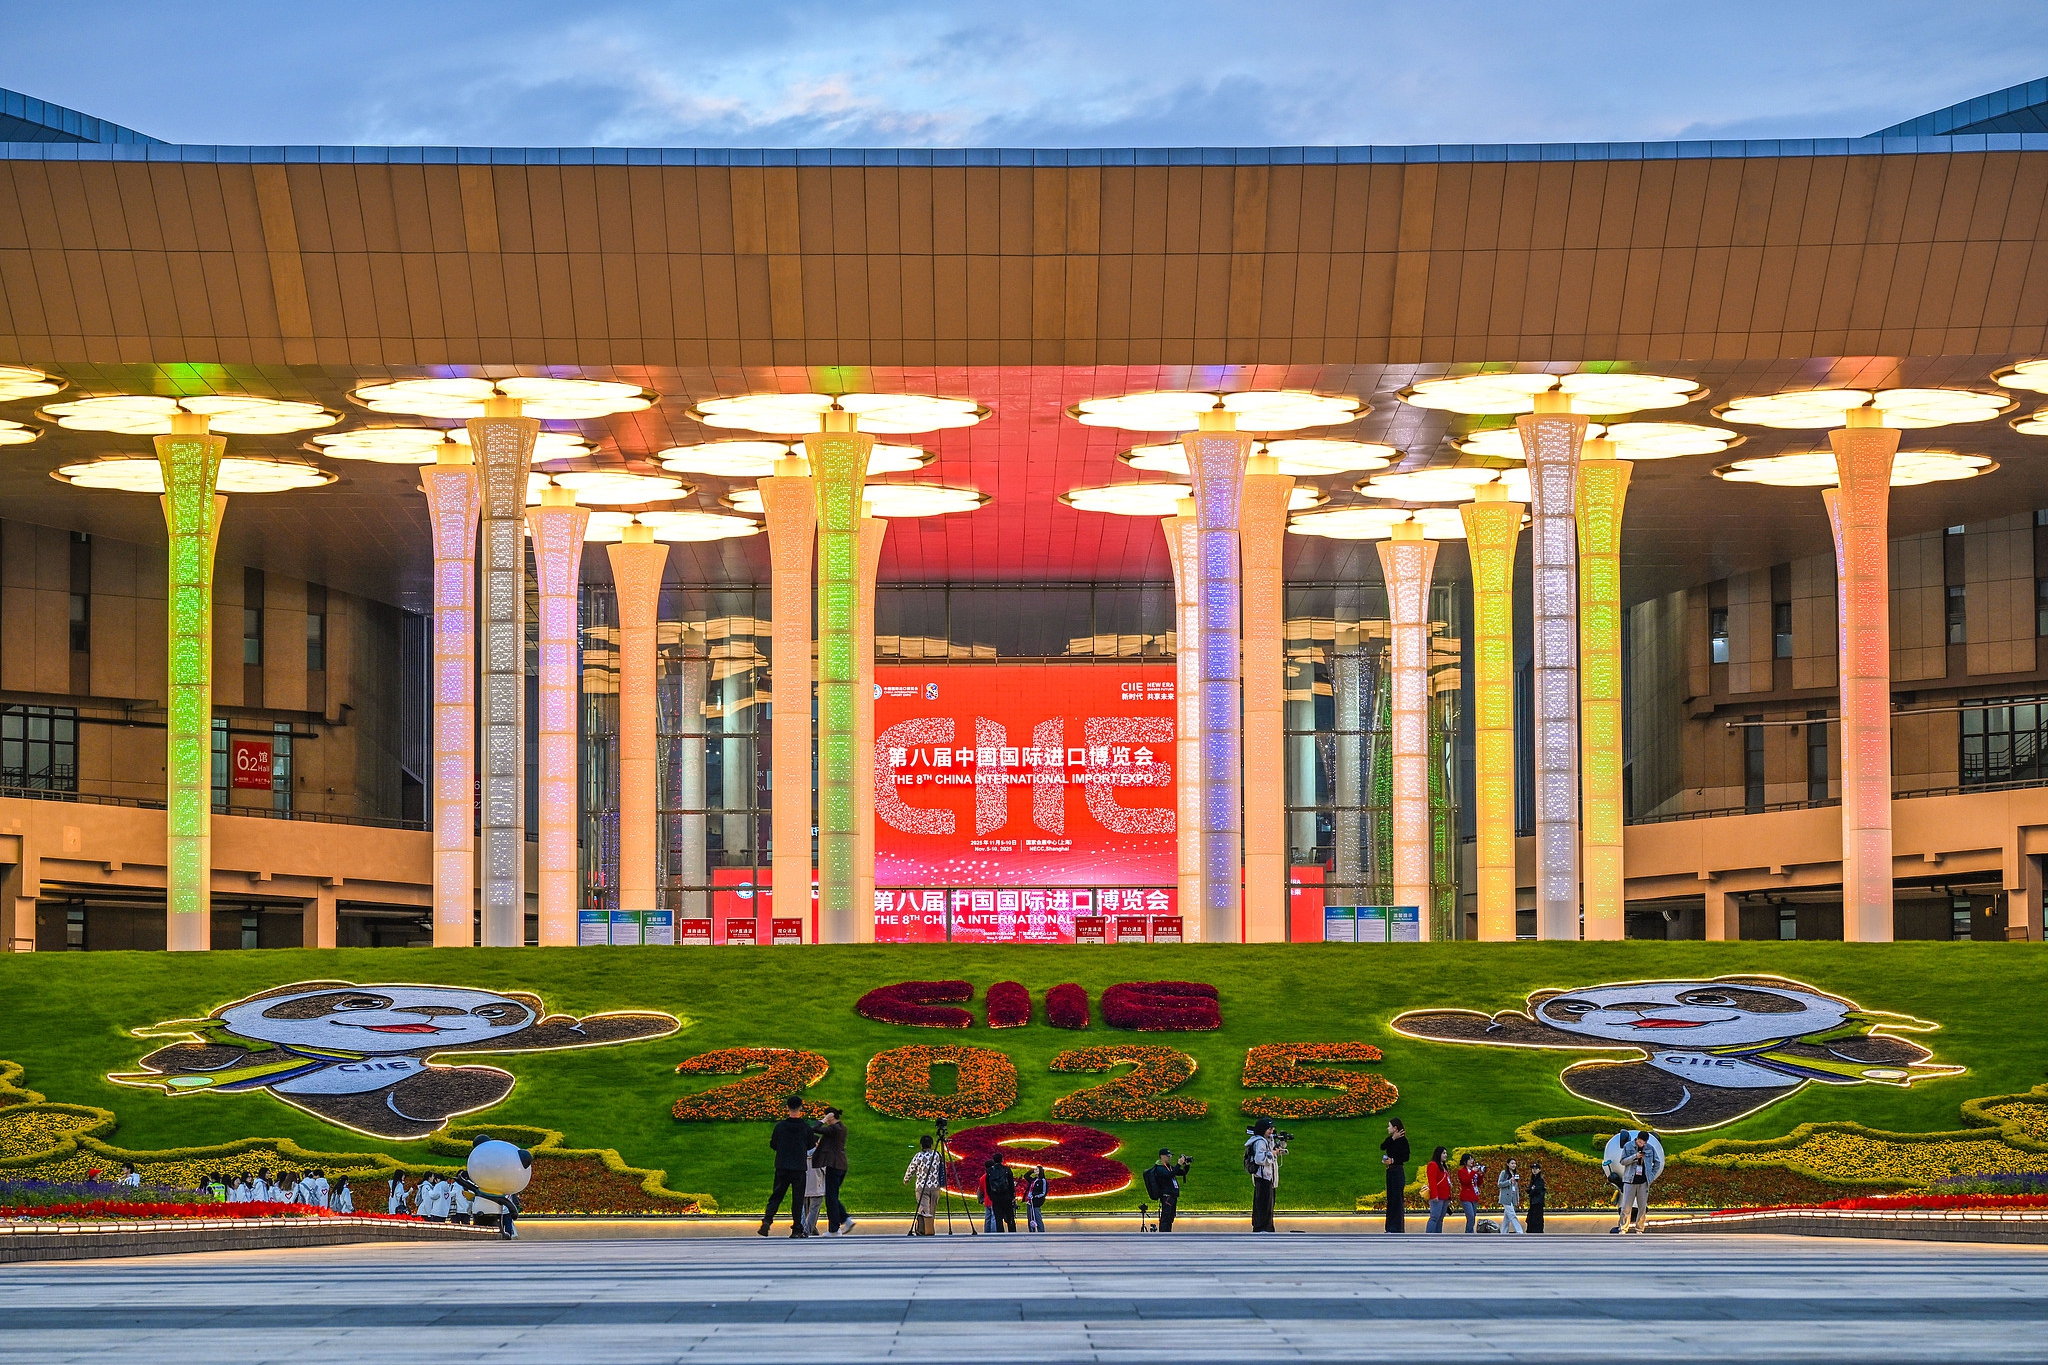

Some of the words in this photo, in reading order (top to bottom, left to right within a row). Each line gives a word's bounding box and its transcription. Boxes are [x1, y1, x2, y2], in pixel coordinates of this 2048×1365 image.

[1121, 682, 1143, 691] CIIE
[237, 748, 258, 772] 6.2
[889, 746, 1154, 768] 第八届中国国际进口博览会
[890, 774, 913, 785] THE
[935, 774, 972, 785] CHINA
[975, 774, 1069, 785] INTERNATIONAL
[1072, 774, 1118, 785] IMPORT
[1120, 774, 1154, 785] EXPO
[875, 890, 1170, 912] 第八届中国国际进口博览会
[874, 914, 899, 925] THE
[968, 914, 1075, 925] INTERNATIONAL
[856, 979, 1223, 1032] CIIE
[338, 1061, 411, 1072] CIIE
[1664, 1056, 1737, 1069] CIIE
[672, 1041, 1400, 1122] 2025
[942, 1120, 1133, 1200] 8
